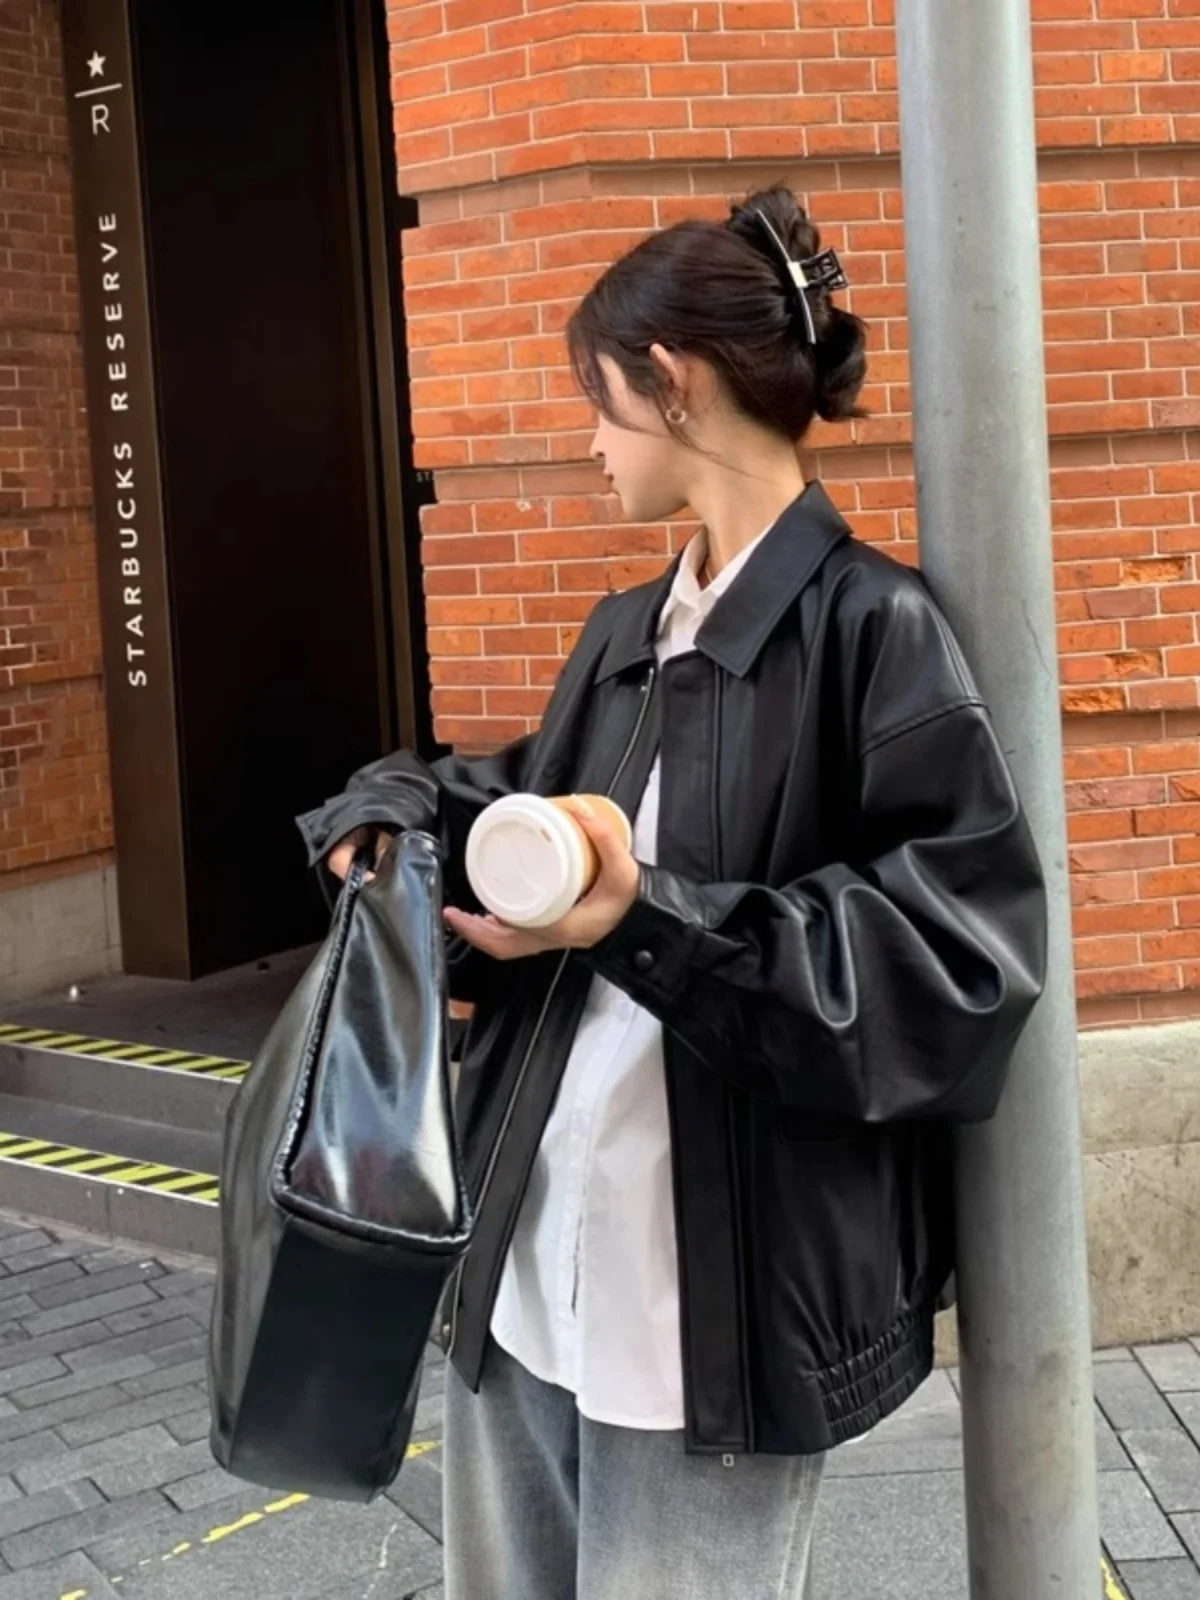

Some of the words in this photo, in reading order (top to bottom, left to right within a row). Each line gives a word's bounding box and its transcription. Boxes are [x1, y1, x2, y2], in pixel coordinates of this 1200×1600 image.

[91, 103, 111, 134] R
[98, 212, 130, 412] RESERVE
[112, 441, 148, 687] STARBUCKS
